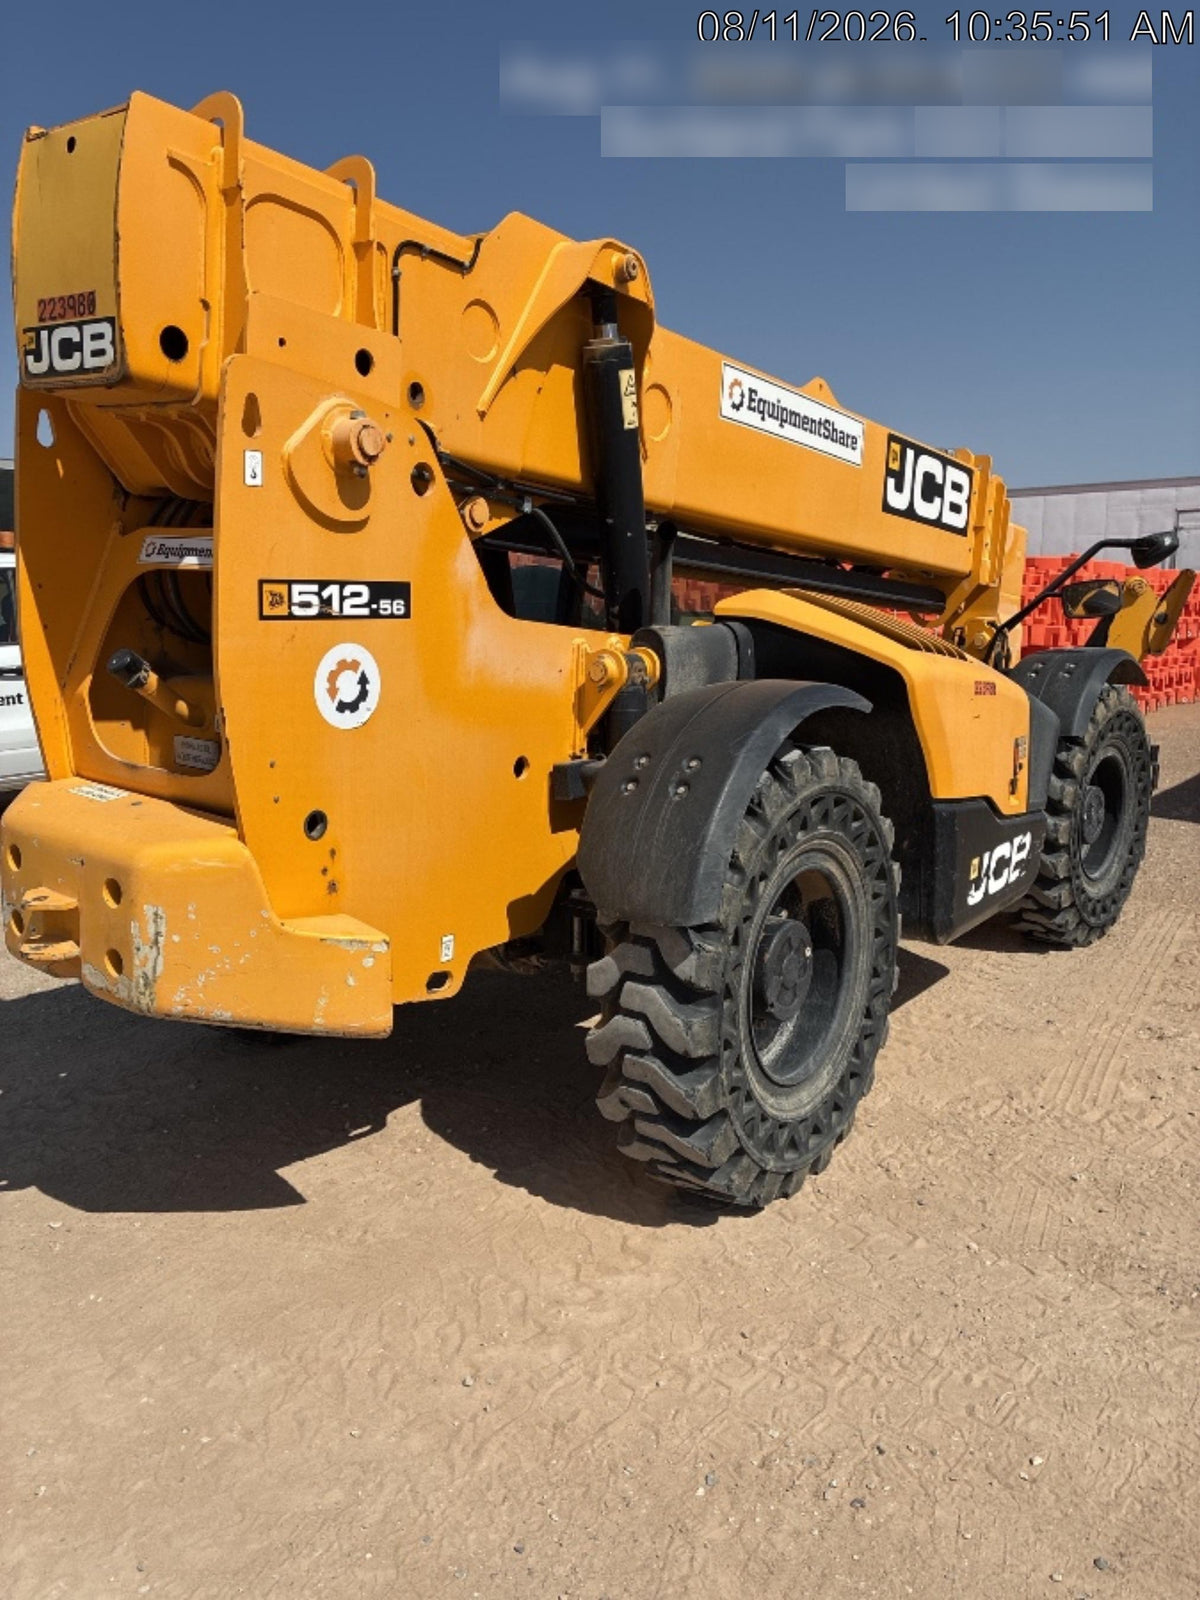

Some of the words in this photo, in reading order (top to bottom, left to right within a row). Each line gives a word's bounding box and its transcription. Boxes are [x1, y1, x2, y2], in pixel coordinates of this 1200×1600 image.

[25, 321, 116, 375] JCB
[747, 387, 858, 451] EquipmentShare
[886, 447, 970, 529] JCB
[290, 583, 406, 616] 512-56
[966, 831, 1032, 906] JCB
